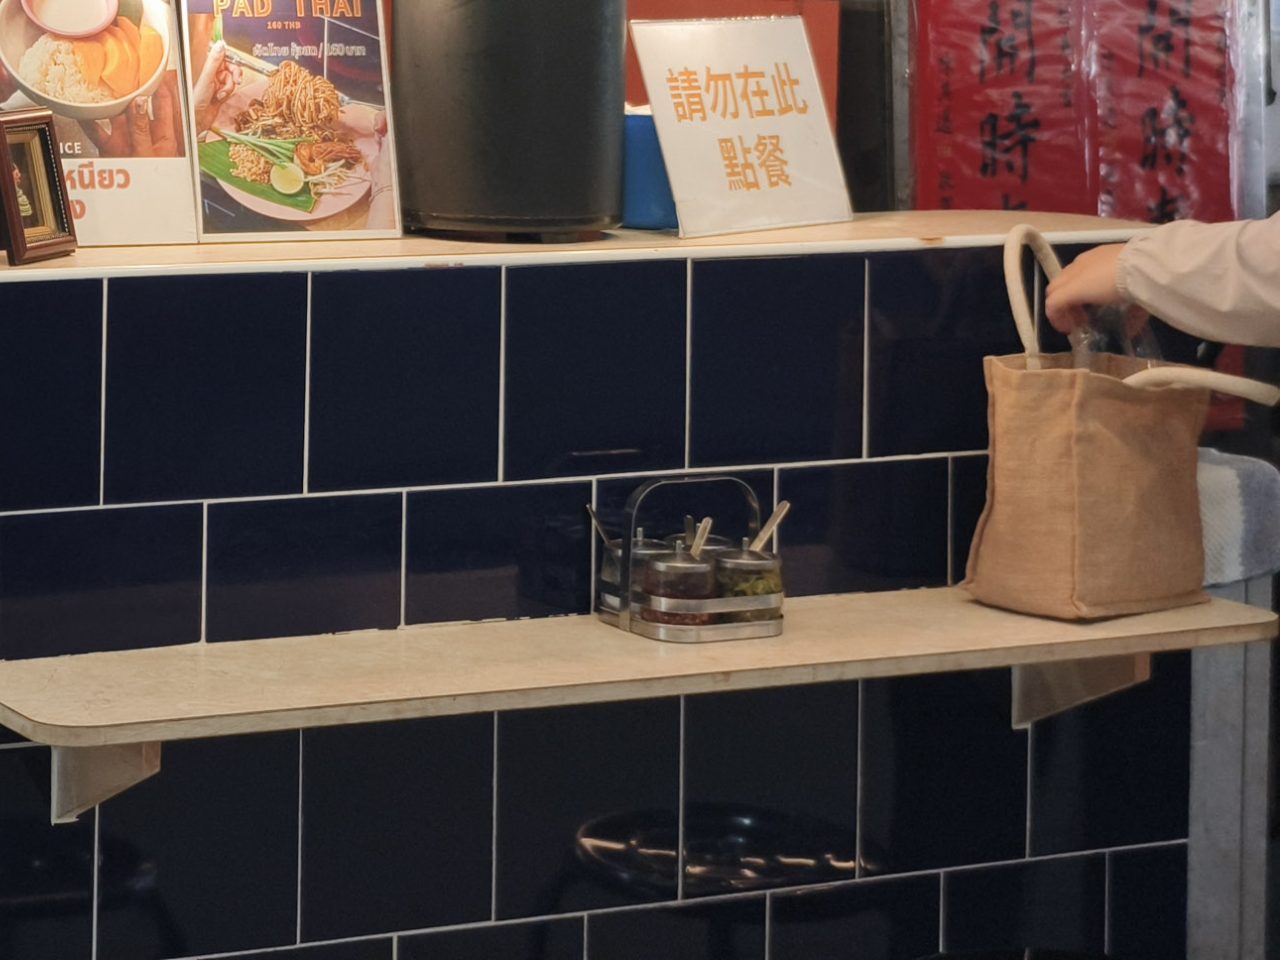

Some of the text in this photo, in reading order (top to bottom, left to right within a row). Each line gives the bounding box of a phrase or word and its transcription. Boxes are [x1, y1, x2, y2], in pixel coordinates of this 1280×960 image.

[665, 62, 809, 123] 請勿在此
[60, 142, 83, 154] ICE
[717, 134, 792, 191] 點餐
